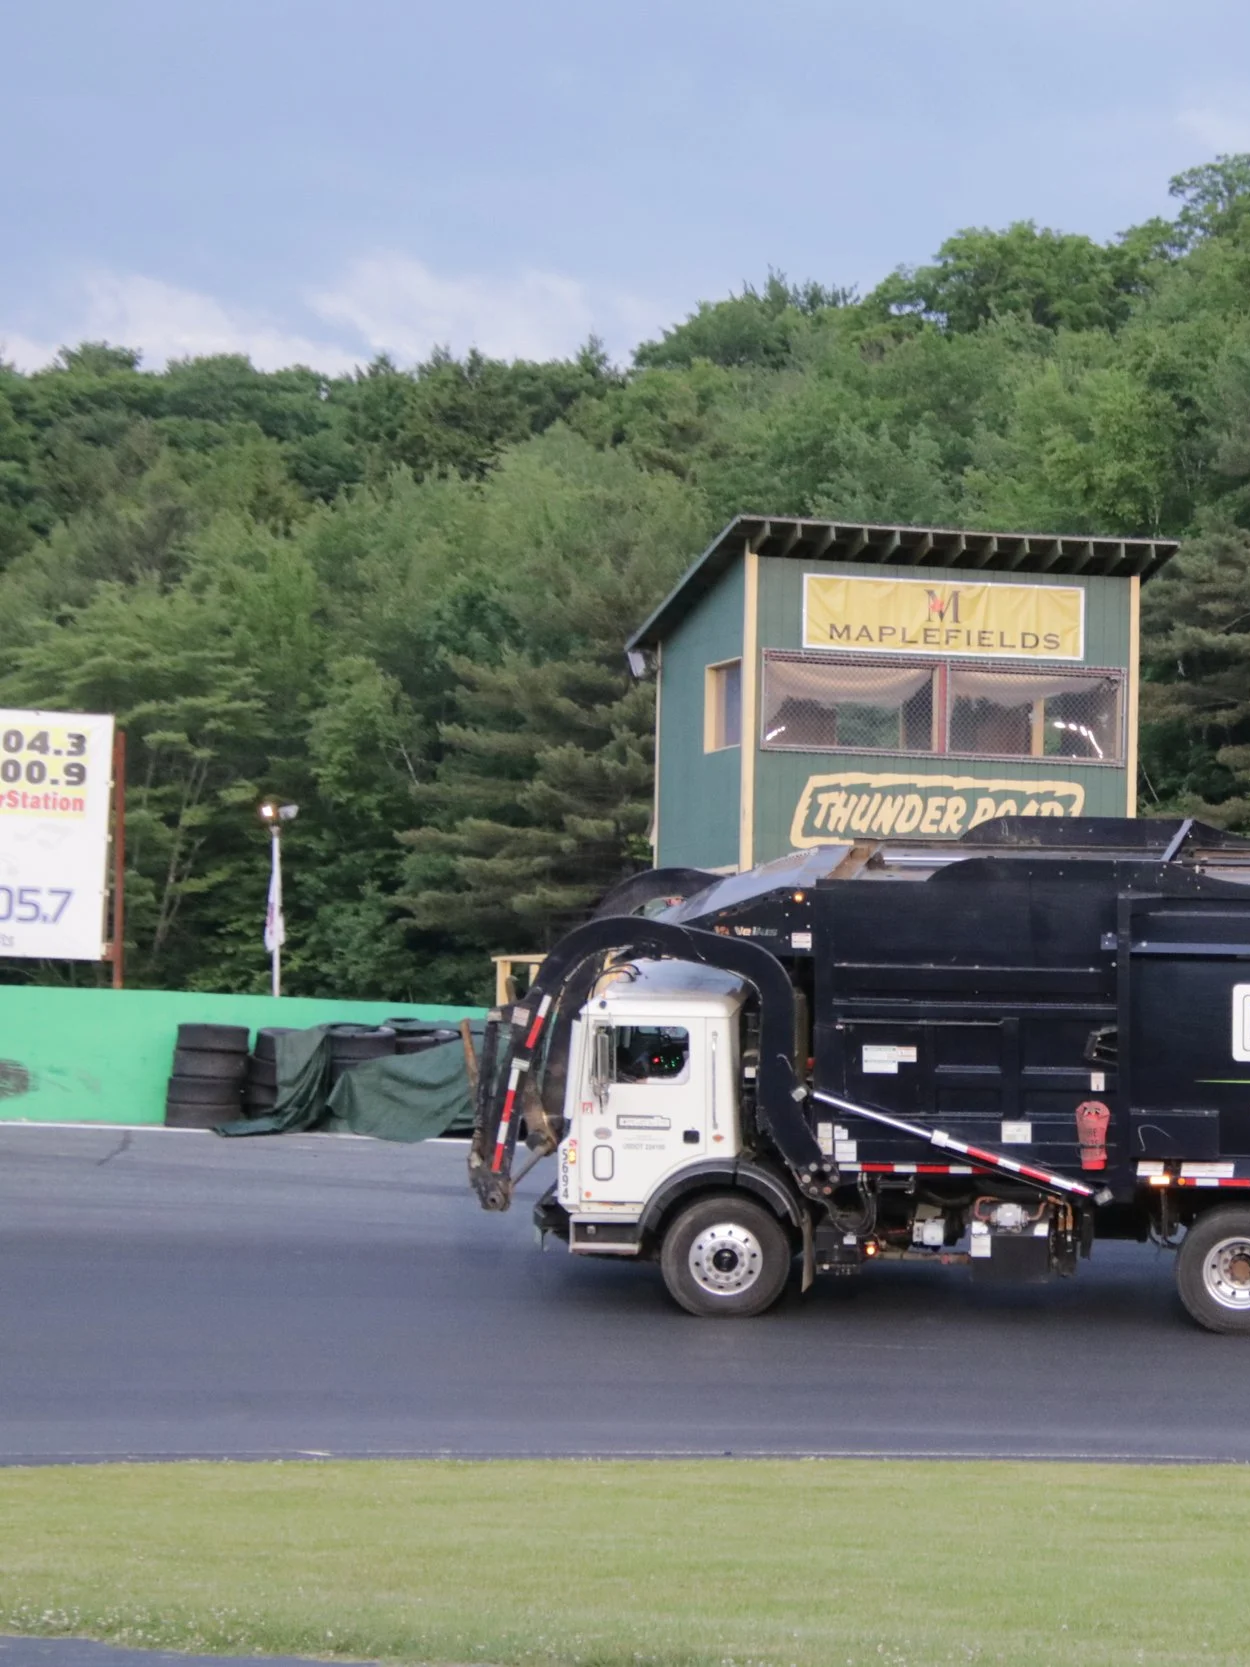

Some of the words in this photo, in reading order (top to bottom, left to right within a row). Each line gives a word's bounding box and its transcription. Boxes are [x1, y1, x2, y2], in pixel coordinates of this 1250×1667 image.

[925, 588, 961, 624] M
[829, 623, 1061, 650] MAPLEFIELDS
[3, 729, 87, 757] 04.3
[1, 758, 87, 786] 00.9
[814, 790, 967, 835] THUNDER
